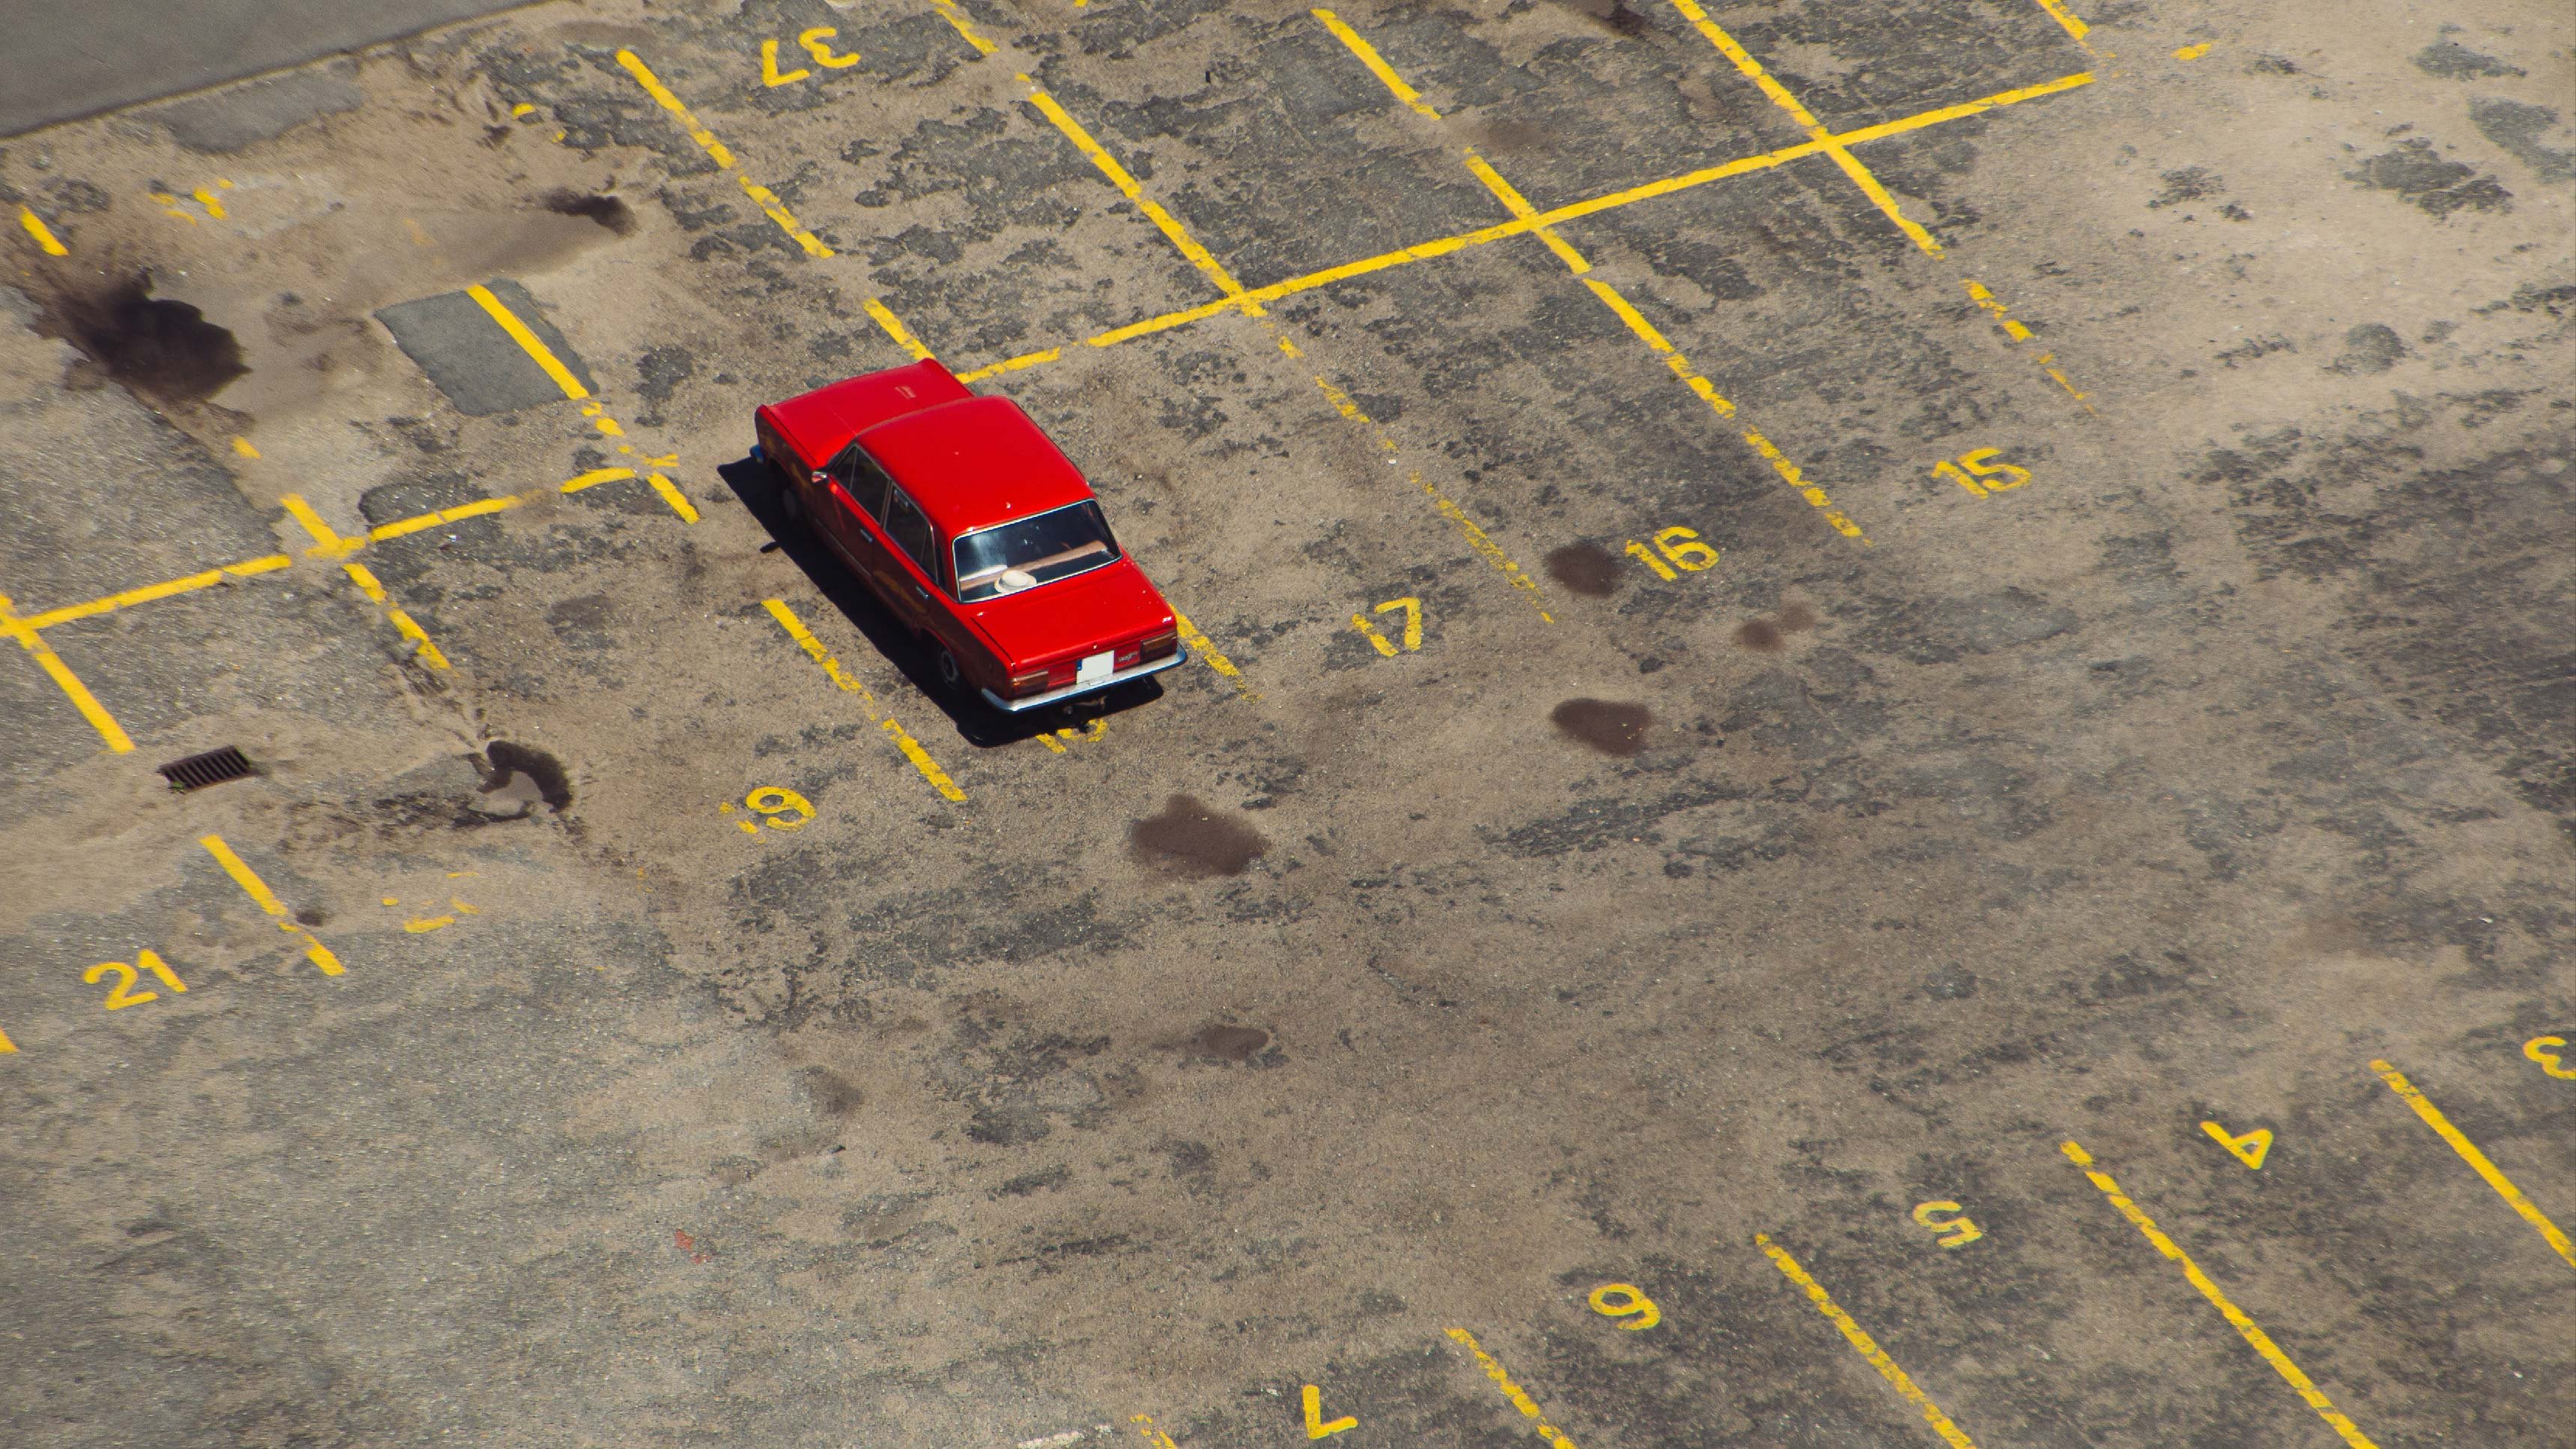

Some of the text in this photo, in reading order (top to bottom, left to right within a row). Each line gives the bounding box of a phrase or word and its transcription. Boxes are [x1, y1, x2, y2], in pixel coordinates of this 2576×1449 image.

[761, 25, 861, 88] 37
[1930, 447, 2033, 500] 15
[1624, 524, 1720, 582] 16
[1350, 596, 1423, 658] 17
[82, 949, 187, 1011] 21
[2524, 1034, 2576, 1080] 3
[2201, 1119, 2274, 1170] 4
[1914, 1199, 1982, 1247] 5
[1300, 1383, 1360, 1440] 7
